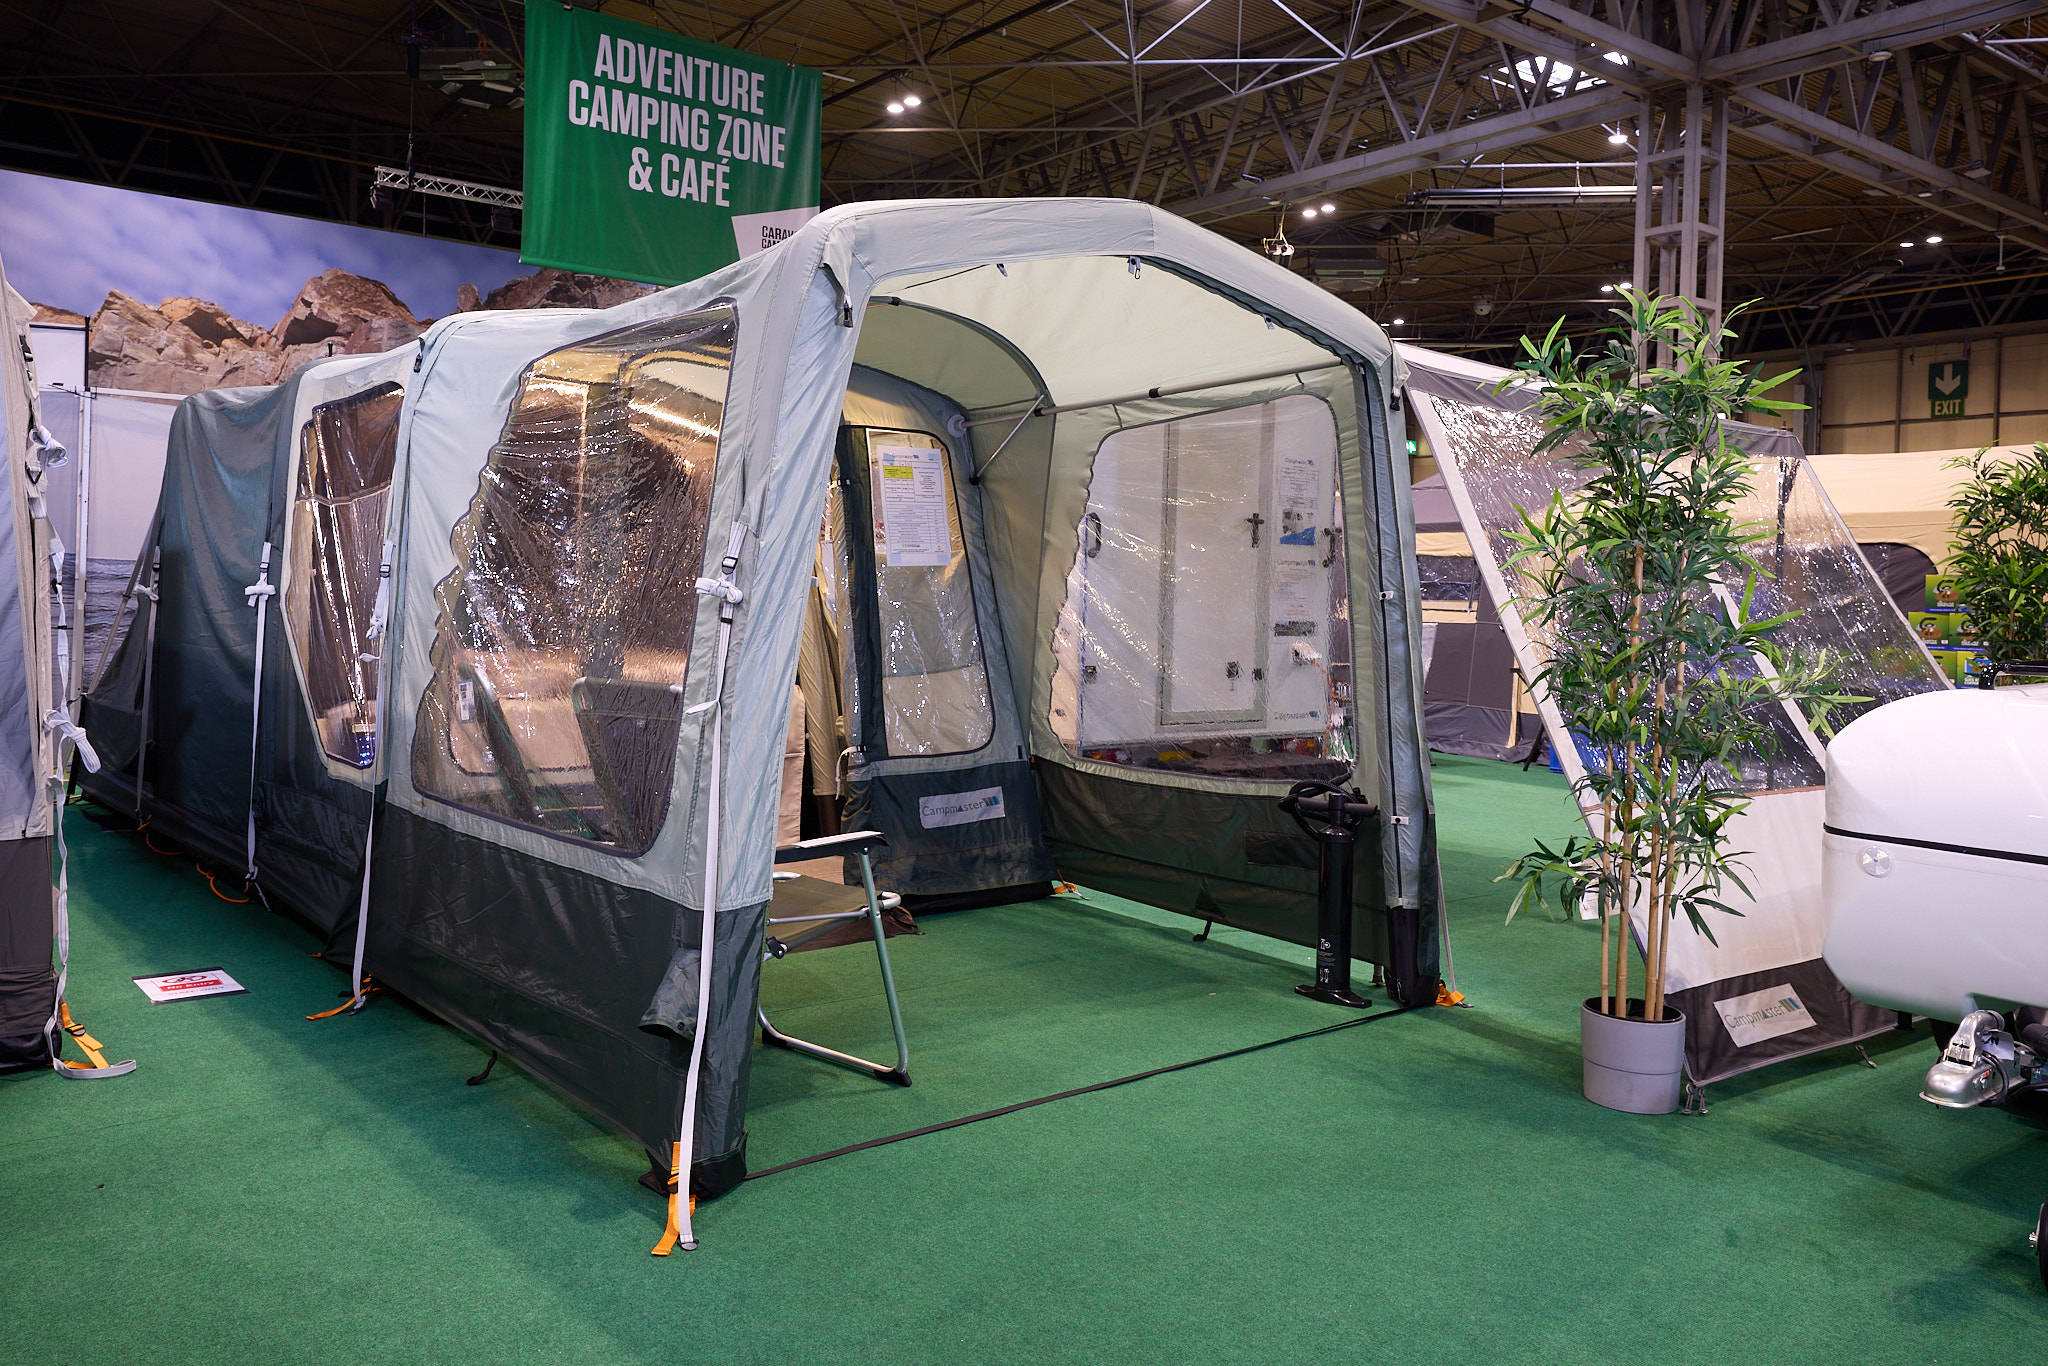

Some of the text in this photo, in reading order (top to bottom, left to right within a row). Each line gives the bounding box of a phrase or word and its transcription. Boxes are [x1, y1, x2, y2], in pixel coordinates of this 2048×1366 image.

[594, 33, 765, 116] ADVENTURE
[568, 79, 786, 169] CAMPING ZONE
[628, 146, 731, 208] & CAFÉ
[1934, 399, 1962, 416] EXIT
